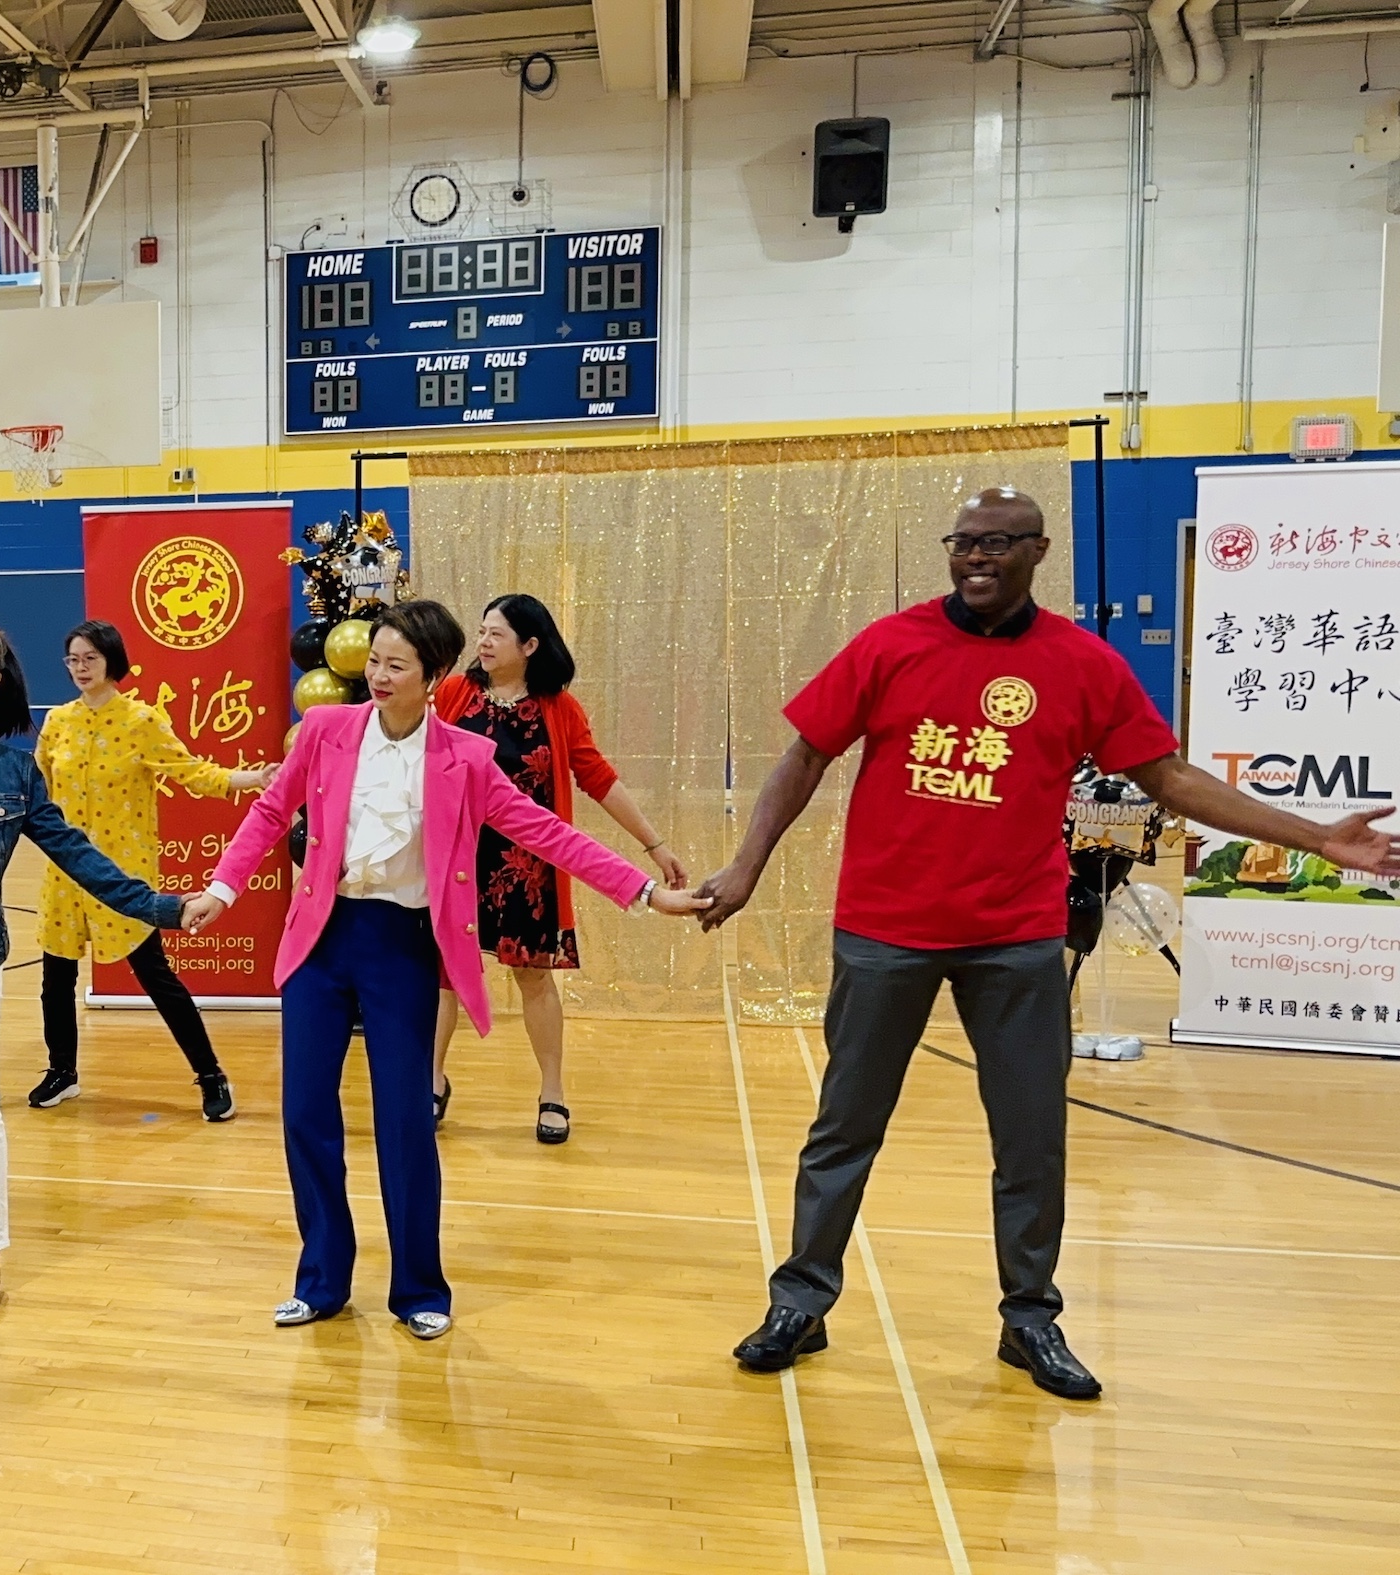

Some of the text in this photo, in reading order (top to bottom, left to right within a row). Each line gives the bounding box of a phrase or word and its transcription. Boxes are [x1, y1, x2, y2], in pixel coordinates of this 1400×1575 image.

[567, 233, 644, 259] VISITOR
[306, 253, 364, 277] HOME
[486, 313, 523, 328] PERIOD
[416, 351, 527, 372] PLAYER FOULS
[582, 346, 626, 363] FOULS
[315, 361, 357, 378] FOULS
[462, 409, 495, 422] GAME
[588, 402, 615, 415] WON
[322, 416, 347, 428] WON
[157, 543, 180, 557] Shore
[181, 540, 212, 554] Chinese
[211, 549, 234, 574] School
[1267, 559, 1309, 571] Jersey
[1313, 558, 1350, 569] Shore
[1206, 608, 1400, 656] 臺灣華語
[908, 717, 1014, 772] 新海
[1281, 800, 1294, 808] for
[1295, 800, 1340, 809] Mandarin
[161, 932, 254, 952] w.jscsnj.org
[1231, 953, 1395, 982] tcml@jscsnj.org
